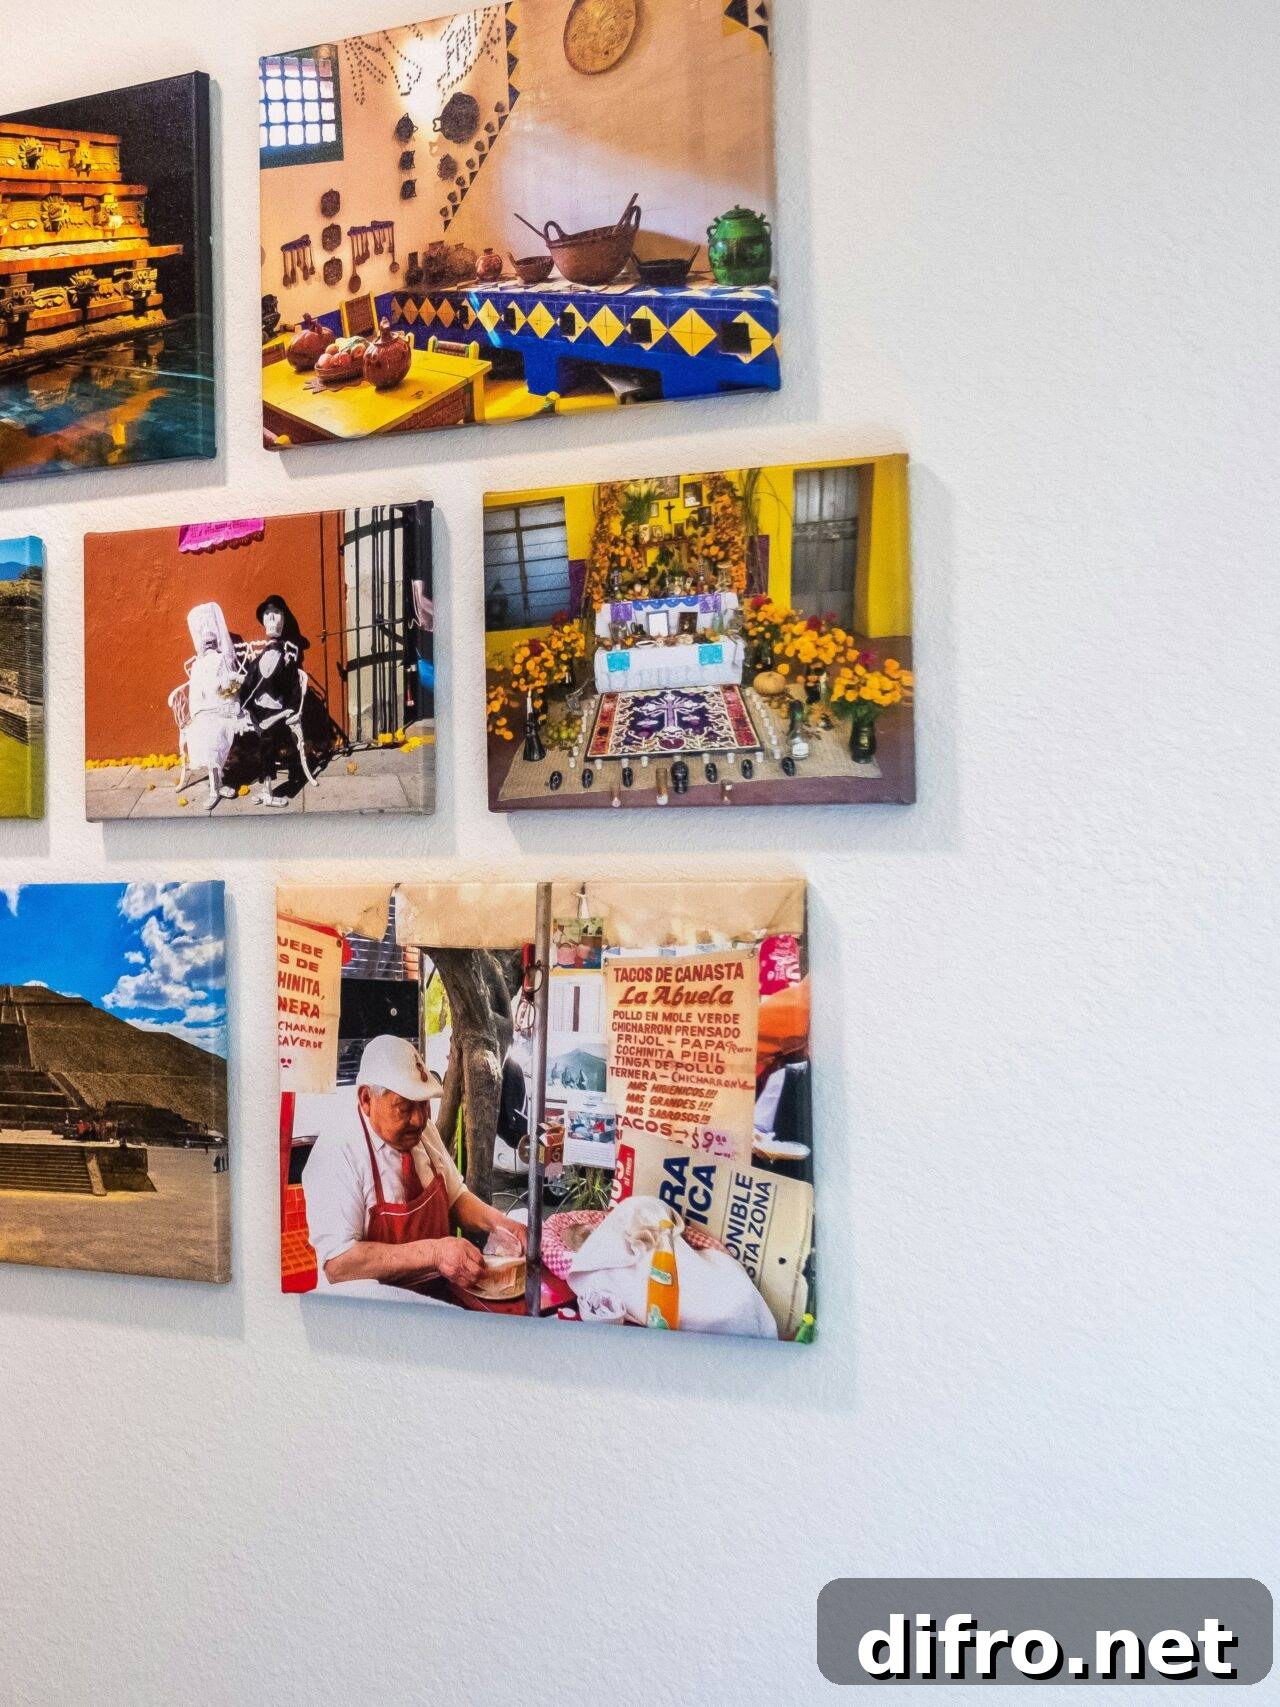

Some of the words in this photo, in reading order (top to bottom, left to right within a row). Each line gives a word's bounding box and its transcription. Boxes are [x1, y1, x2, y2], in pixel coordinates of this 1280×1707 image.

[296, 957, 319, 973] DE
[614, 966, 653, 983] TACOS
[655, 966, 673, 983] DE
[675, 962, 745, 983] CANASTA
[619, 985, 648, 1006] La
[651, 984, 735, 1007] Abuela
[278, 995, 321, 1019] NERA
[613, 1010, 643, 1021] POLLO
[645, 1011, 659, 1022] EN
[662, 1012, 693, 1023] MOLE
[697, 1013, 741, 1025] VERDE
[611, 1021, 672, 1035] CHICHARRON
[675, 1025, 741, 1039] PRENSADO
[617, 1034, 664, 1047] FRIJOL
[681, 1037, 726, 1052] PAPA
[616, 1044, 674, 1060] COCHINITA
[681, 1051, 726, 1064] PIBIL
[614, 1055, 651, 1068] TINGA
[654, 1059, 670, 1071] DE
[675, 1061, 726, 1075] POLLO
[609, 1066, 658, 1082] TERNERA
[671, 1072, 738, 1089] CHICHARRON
[626, 1093, 645, 1104] MAS
[650, 1095, 697, 1111] GRANDES
[626, 1105, 644, 1116] MAS
[615, 1114, 673, 1137] TACOS
[659, 1156, 691, 1216] RA
[686, 1164, 717, 1226] ICA
[725, 1172, 754, 1260] ONIBLE
[748, 1181, 772, 1238] ZONA
